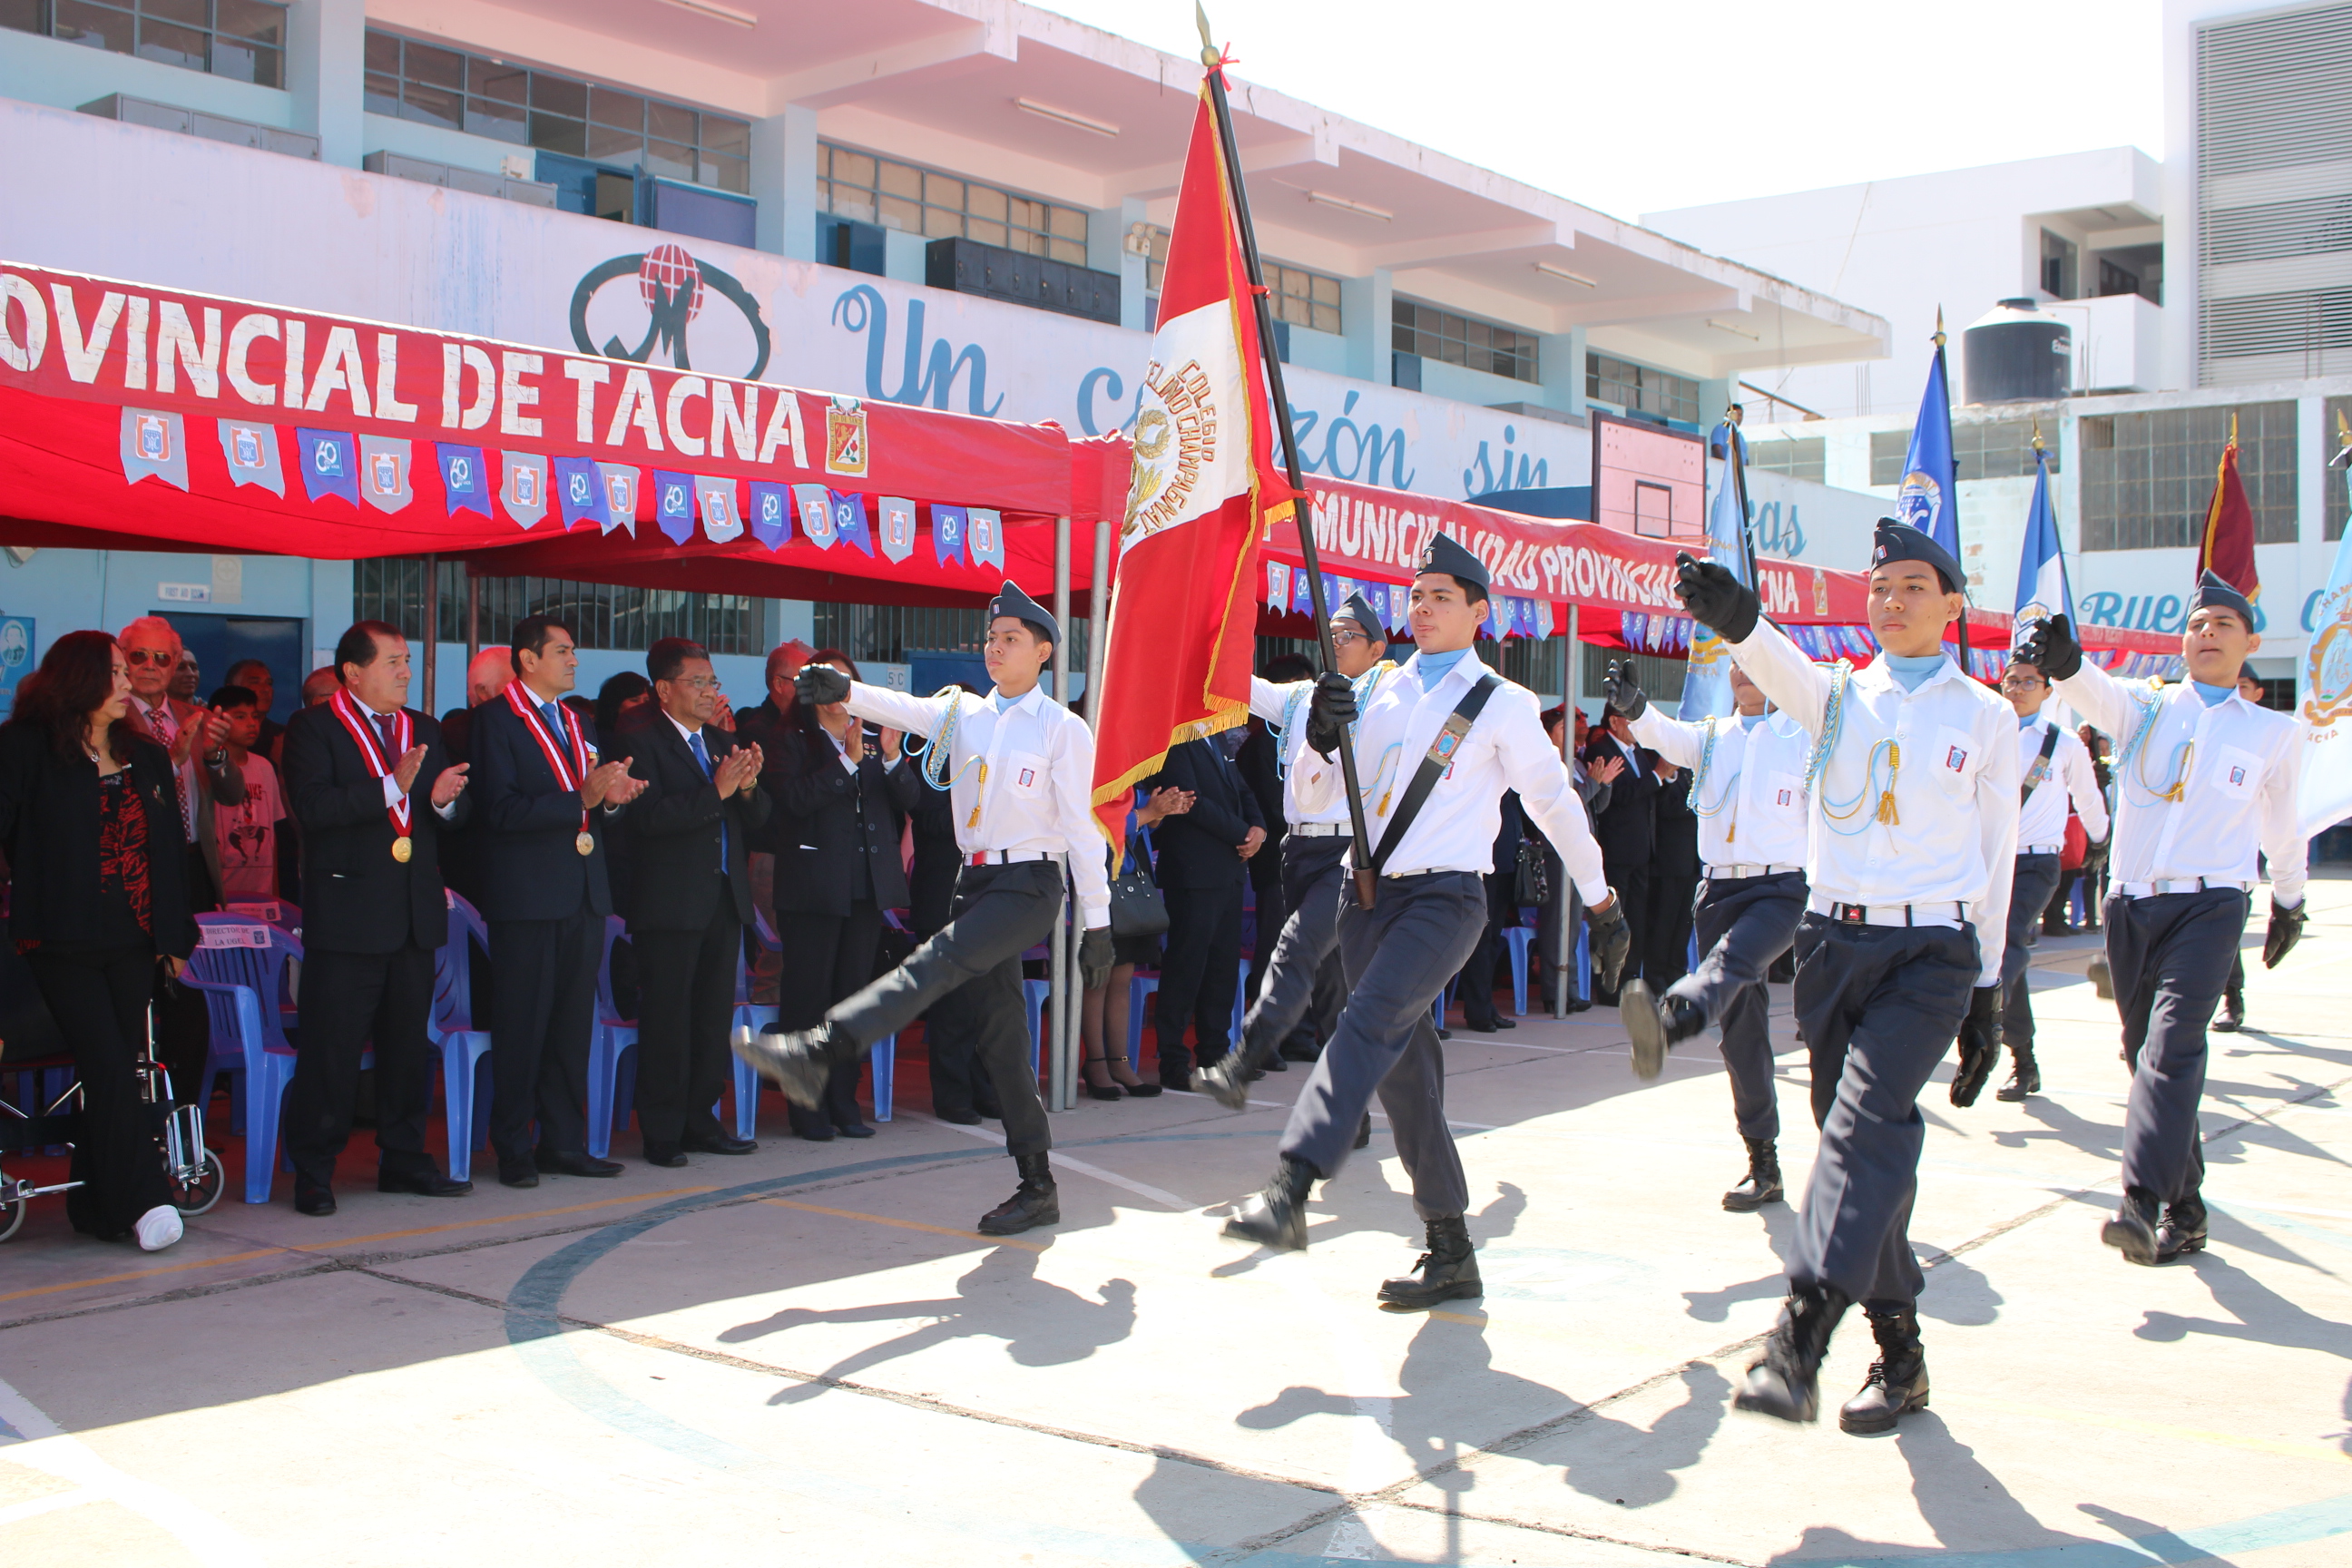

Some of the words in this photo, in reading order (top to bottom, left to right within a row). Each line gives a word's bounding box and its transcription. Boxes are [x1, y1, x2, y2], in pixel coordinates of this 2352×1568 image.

[441, 342, 544, 438] DE
[564, 358, 810, 470] TACNA
[831, 283, 1004, 418] Un
[1177, 358, 1217, 463] COLEGIO
[1139, 411, 1202, 536] CHAMPAGNAT
[1757, 568, 1800, 613] CNA
[206, 926, 240, 935] DIRECTOR
